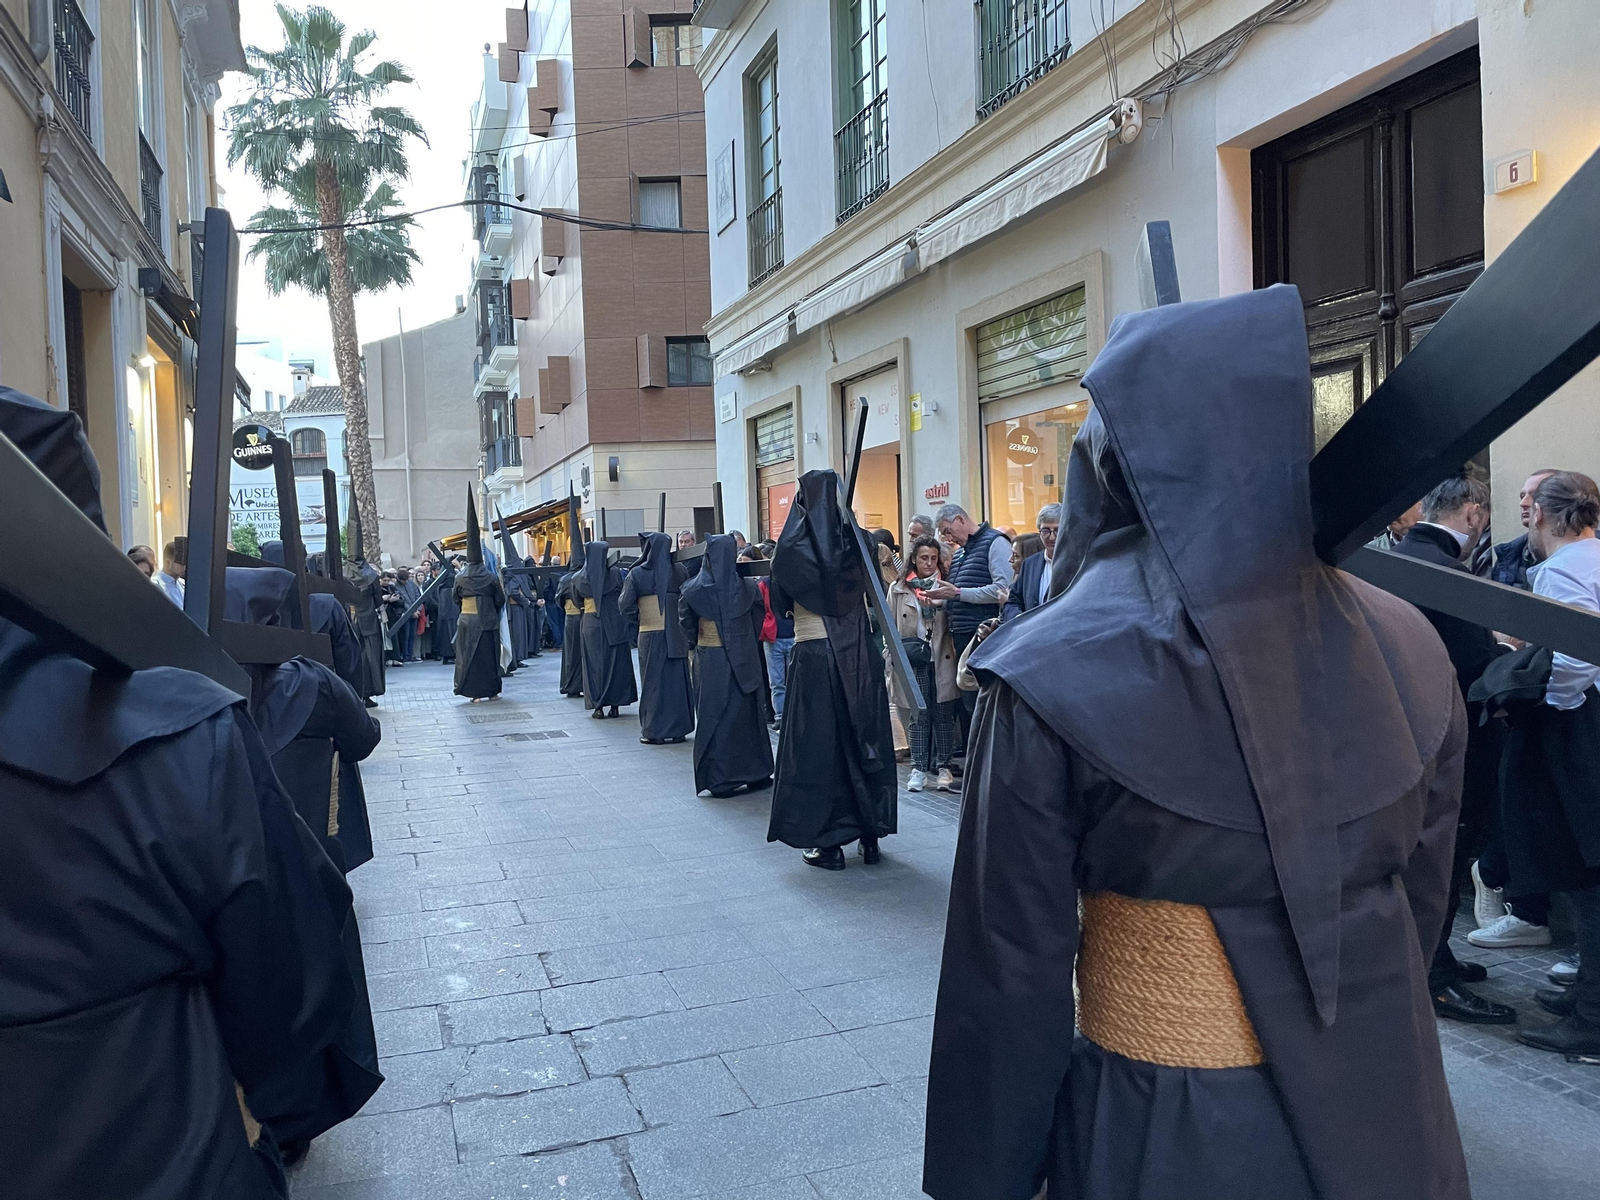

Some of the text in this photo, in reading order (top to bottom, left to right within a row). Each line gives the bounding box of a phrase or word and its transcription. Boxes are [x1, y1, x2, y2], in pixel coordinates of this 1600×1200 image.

[1509, 162, 1518, 183] 6
[233, 444, 273, 458] GUINNES
[925, 481, 949, 499] astrid
[245, 511, 280, 522] ARTES
